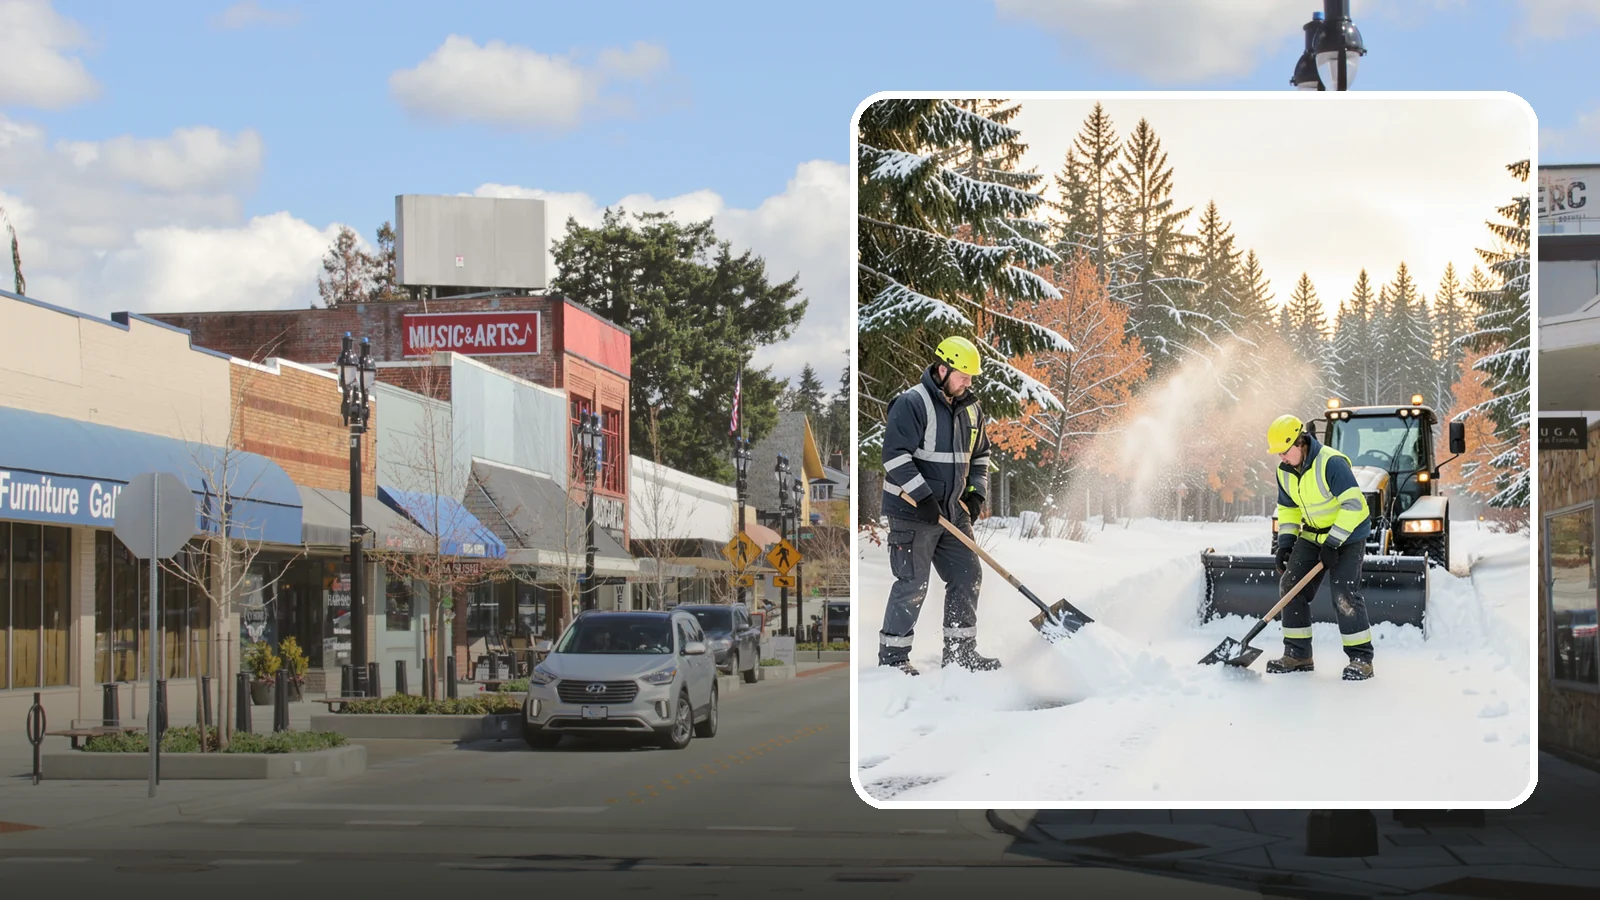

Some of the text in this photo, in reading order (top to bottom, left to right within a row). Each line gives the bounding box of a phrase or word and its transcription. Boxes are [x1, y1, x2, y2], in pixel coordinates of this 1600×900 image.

[0, 471, 122, 519] Furniture Gal
[453, 564, 479, 574] SUSHI
